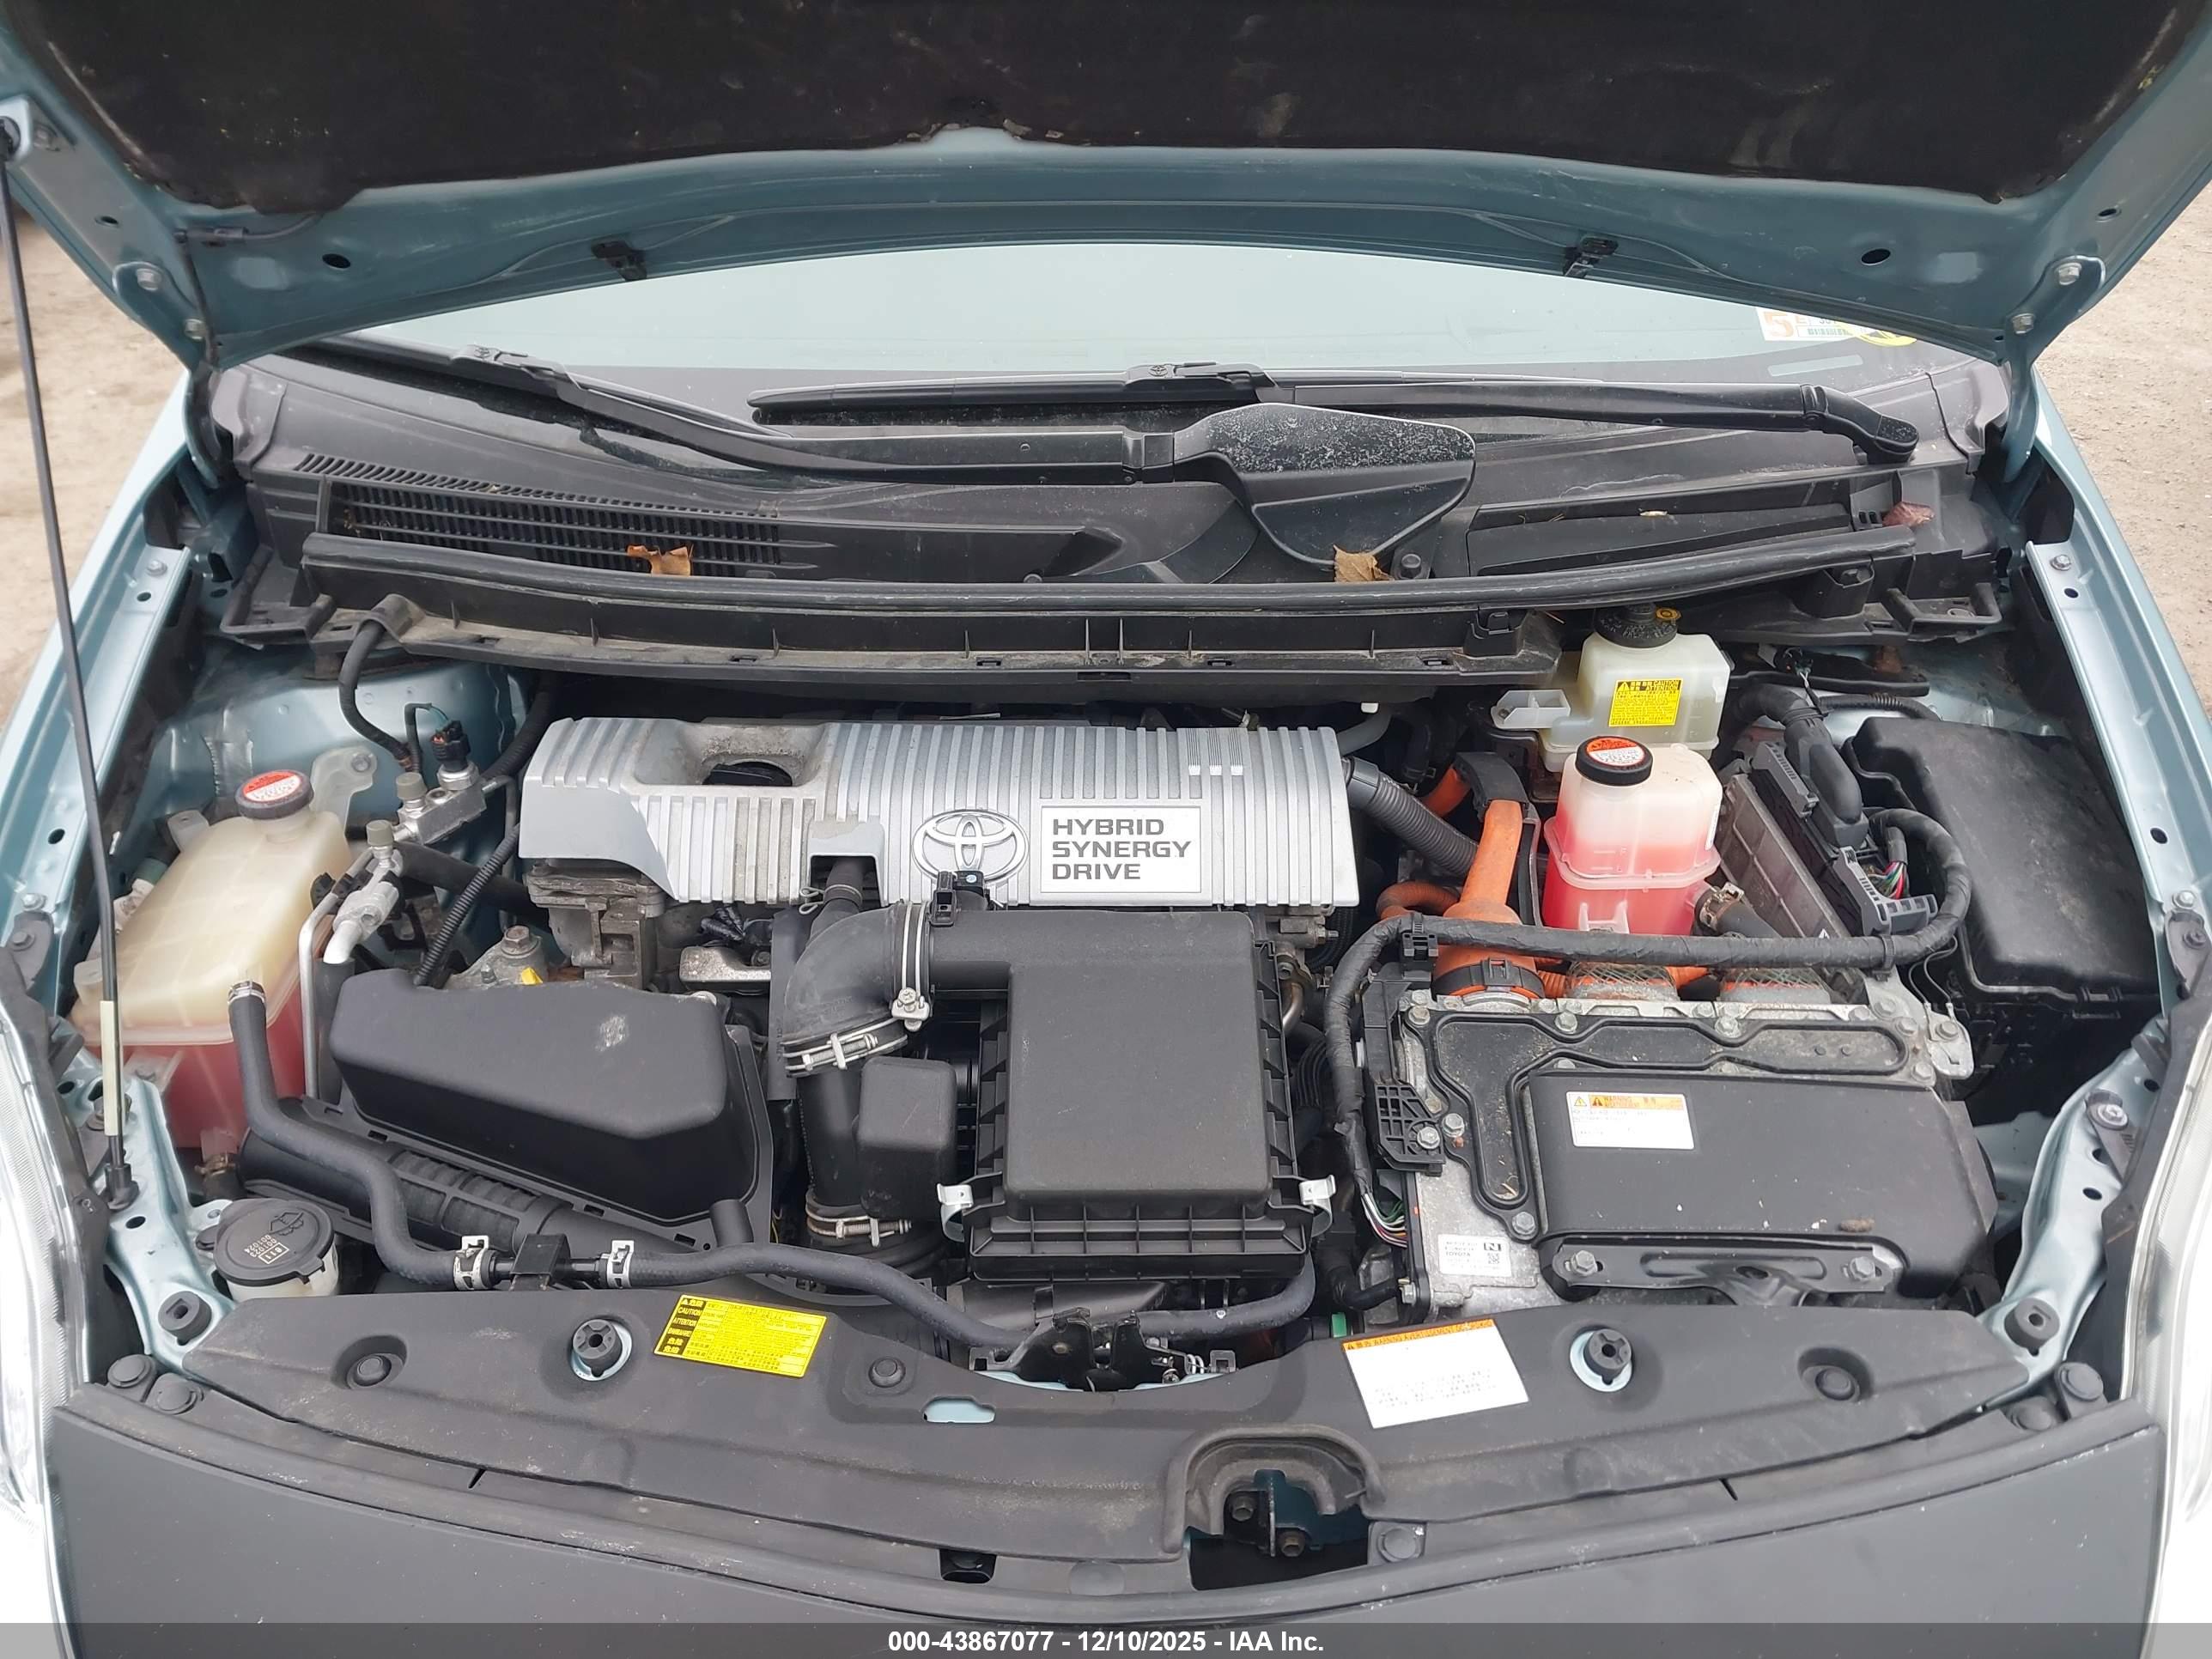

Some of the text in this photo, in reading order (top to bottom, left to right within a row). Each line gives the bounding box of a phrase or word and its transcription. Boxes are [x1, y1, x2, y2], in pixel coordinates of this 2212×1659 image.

[1763, 311, 1795, 337] 5
[1052, 818, 1165, 836] HYBRID
[1052, 842, 1192, 858] SYNERGY
[1052, 864, 1141, 880] DRIVE
[678, 1307, 702, 1316] CAUTION
[672, 1317, 697, 1327] ATTENTION
